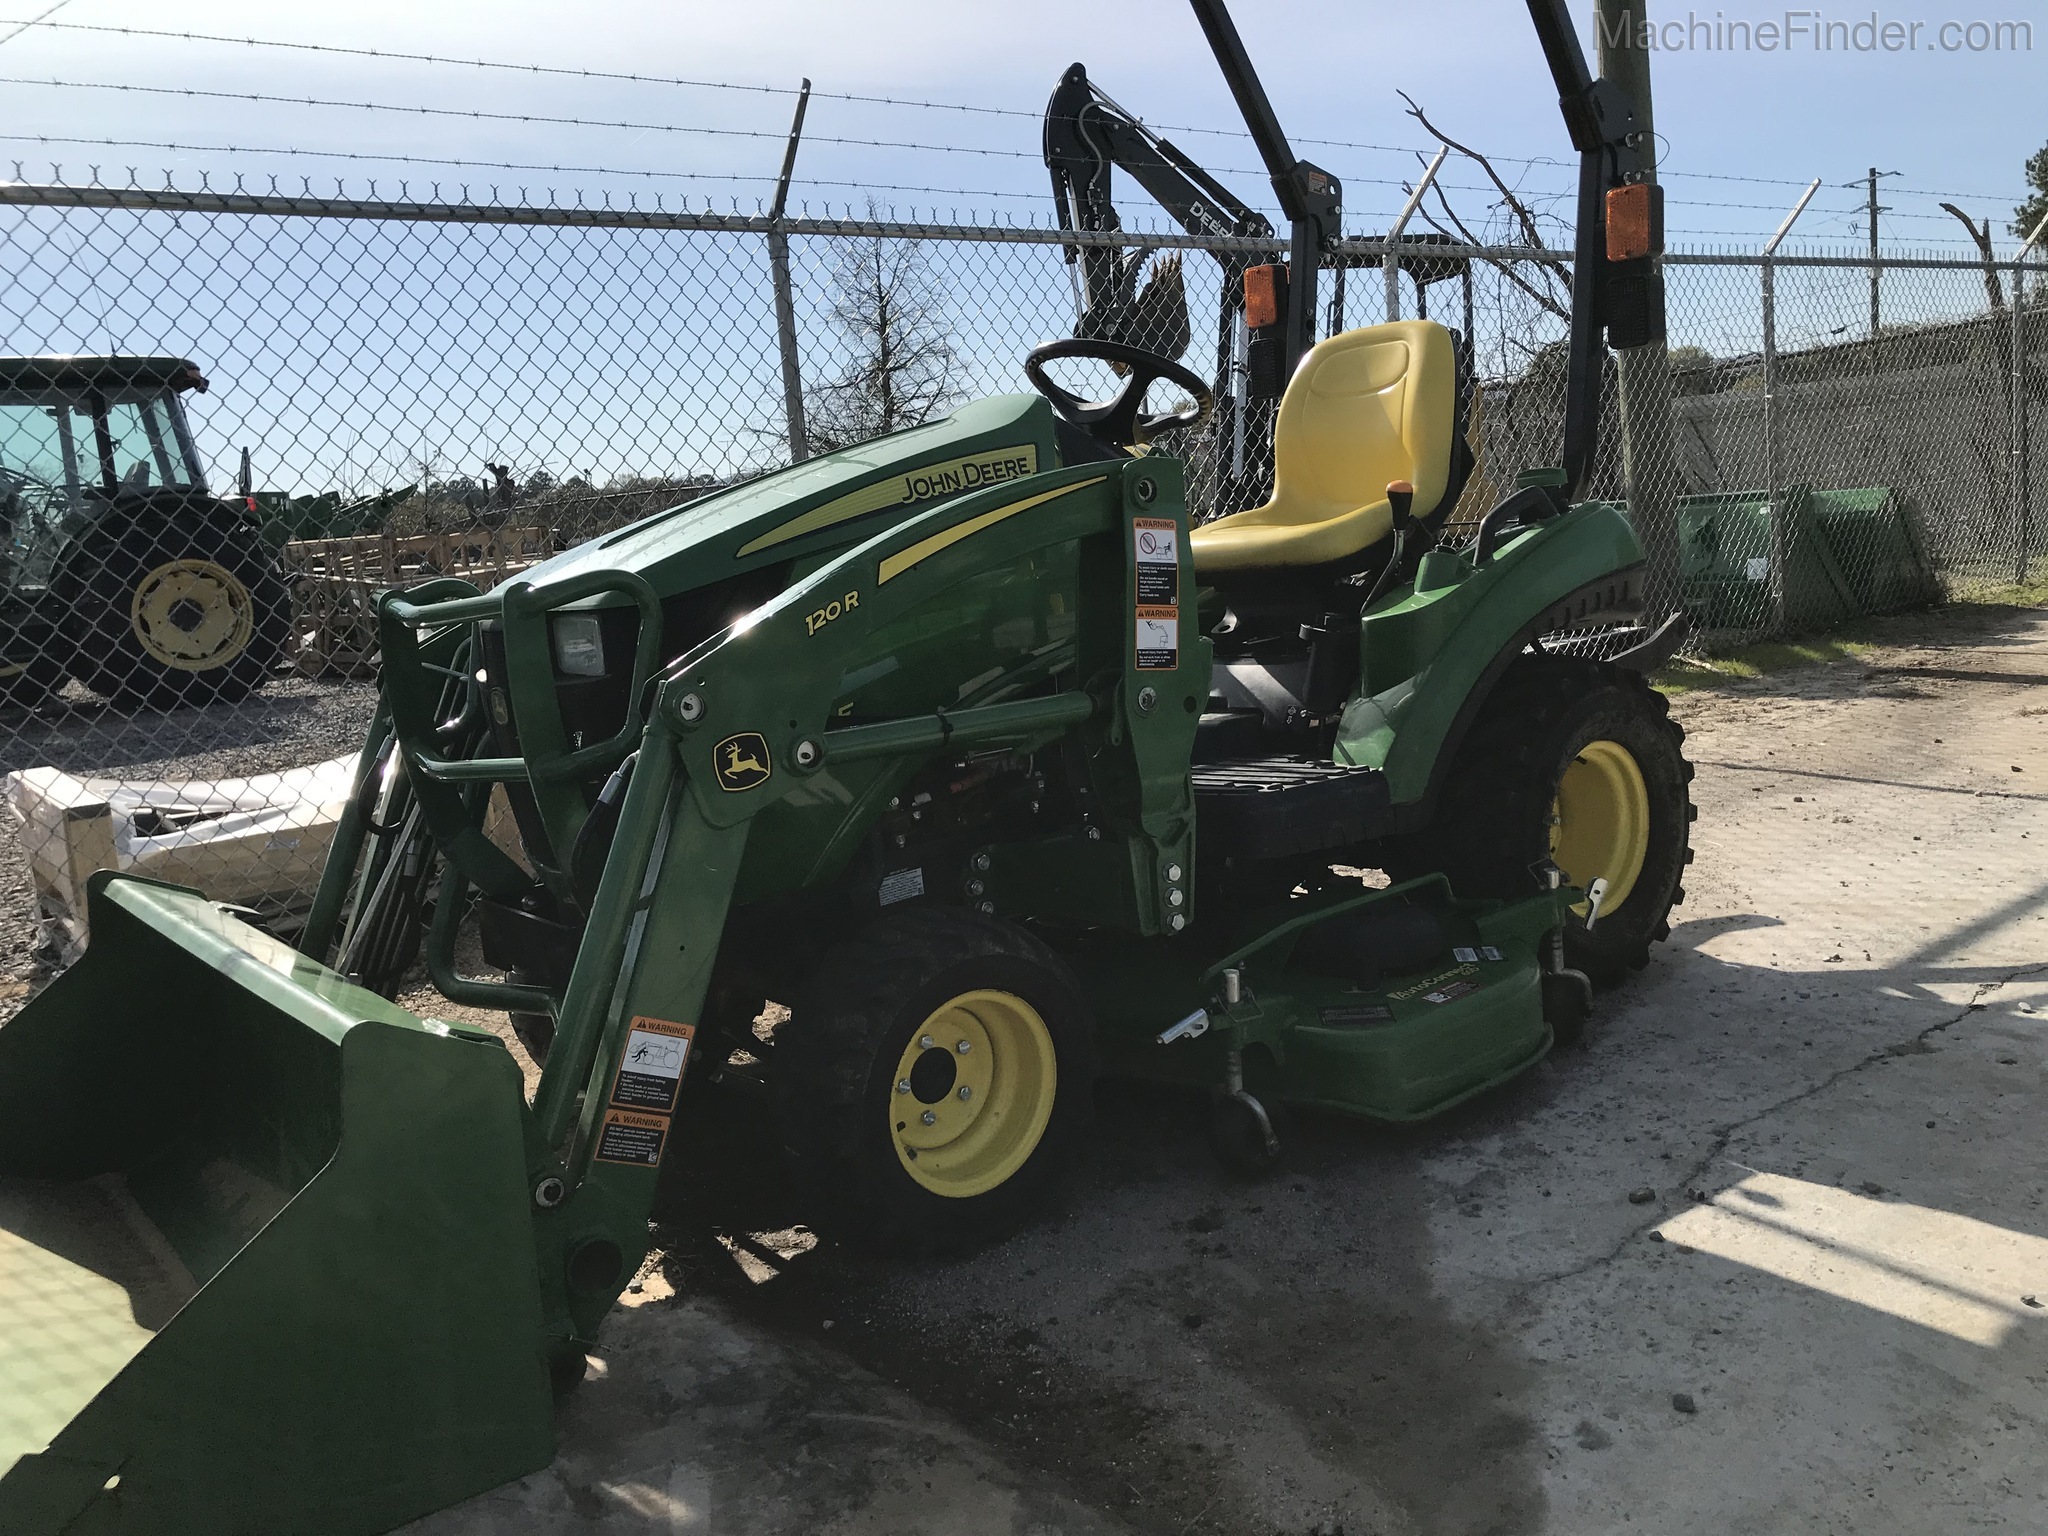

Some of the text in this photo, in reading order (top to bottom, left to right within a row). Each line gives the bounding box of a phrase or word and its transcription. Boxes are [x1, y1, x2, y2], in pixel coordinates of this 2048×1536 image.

[1141, 519, 1175, 529] WARNING
[1144, 609, 1177, 619] WARNING
[648, 1022, 687, 1036] WARNING
[623, 1115, 662, 1128] WARNING
